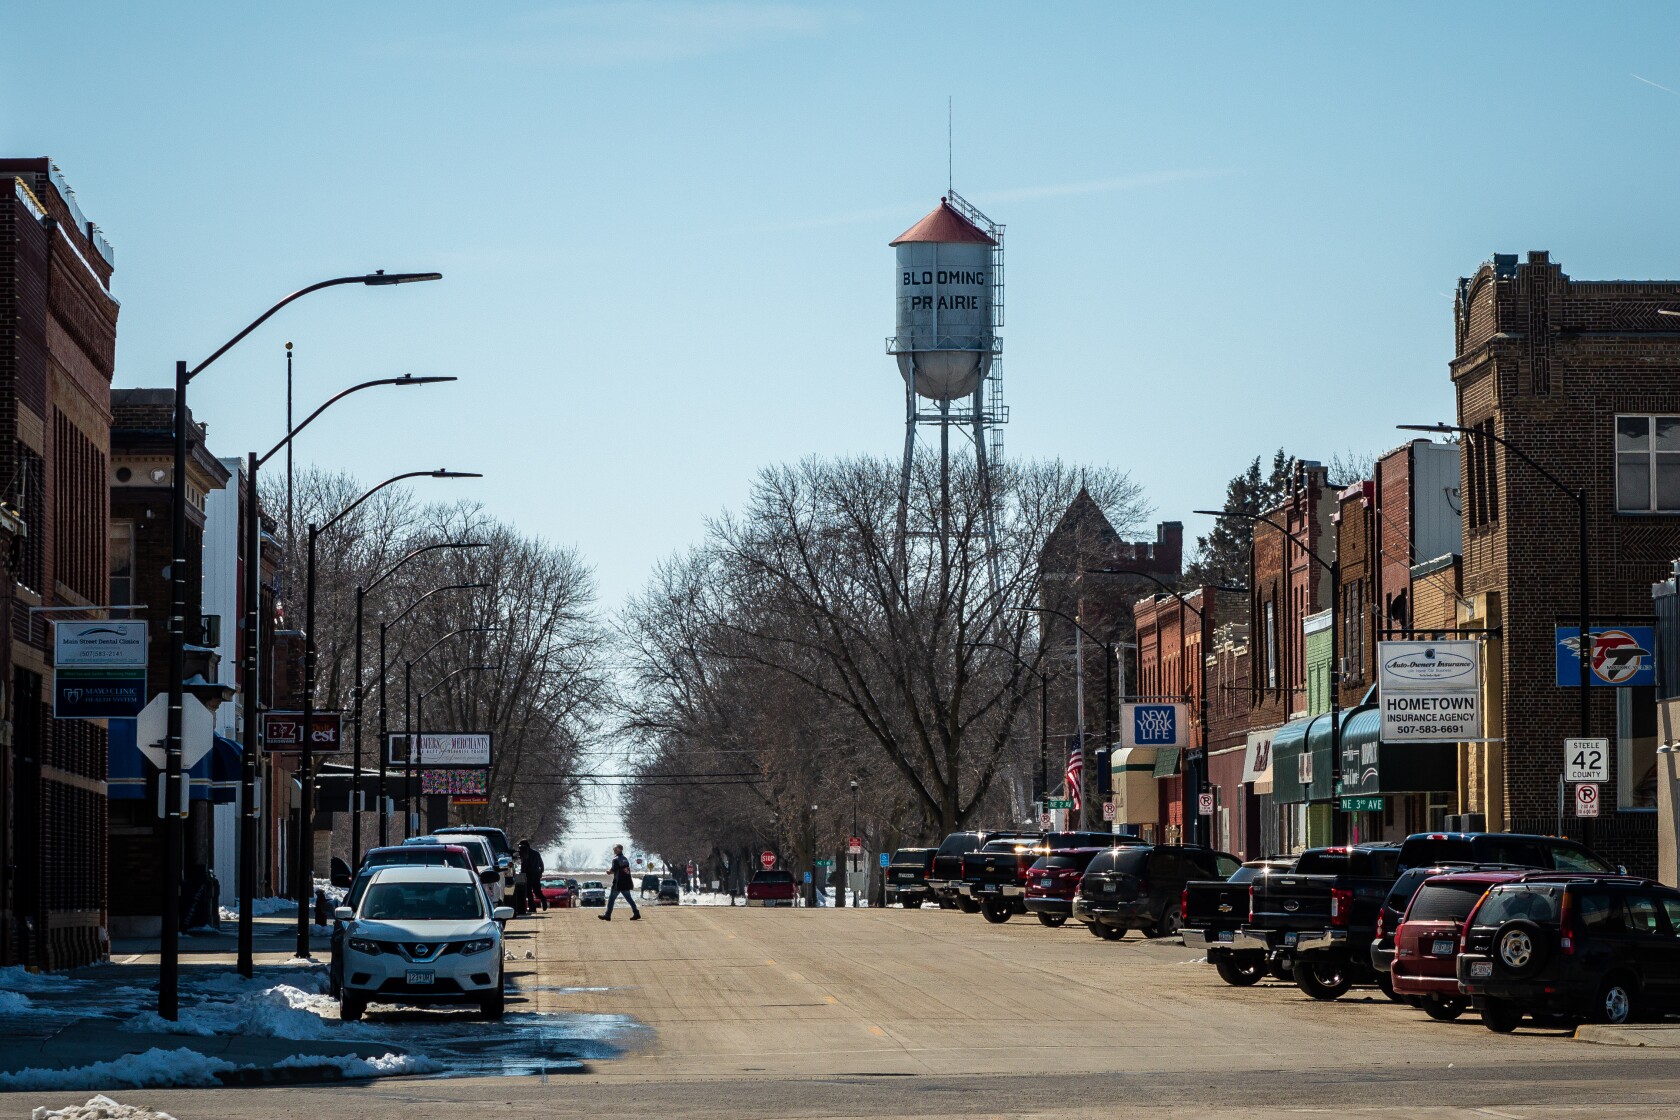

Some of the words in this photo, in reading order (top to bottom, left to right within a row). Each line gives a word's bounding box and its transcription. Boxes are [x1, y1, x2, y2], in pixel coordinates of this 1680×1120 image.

[903, 270, 984, 286] BLOOMING
[912, 296, 978, 310] PRAIRIE
[1387, 698, 1474, 710] HOMETOWN
[1142, 710, 1170, 721] NEW
[1388, 714, 1437, 722] INSURANCE
[1439, 713, 1475, 722] AGENCY
[1136, 719, 1173, 730] YORK
[1397, 725, 1464, 734] 507-583-6691
[1142, 729, 1170, 740] LIFE
[1572, 751, 1601, 770] 42
[1342, 799, 1351, 809] NE
[1368, 799, 1382, 809] AVE
